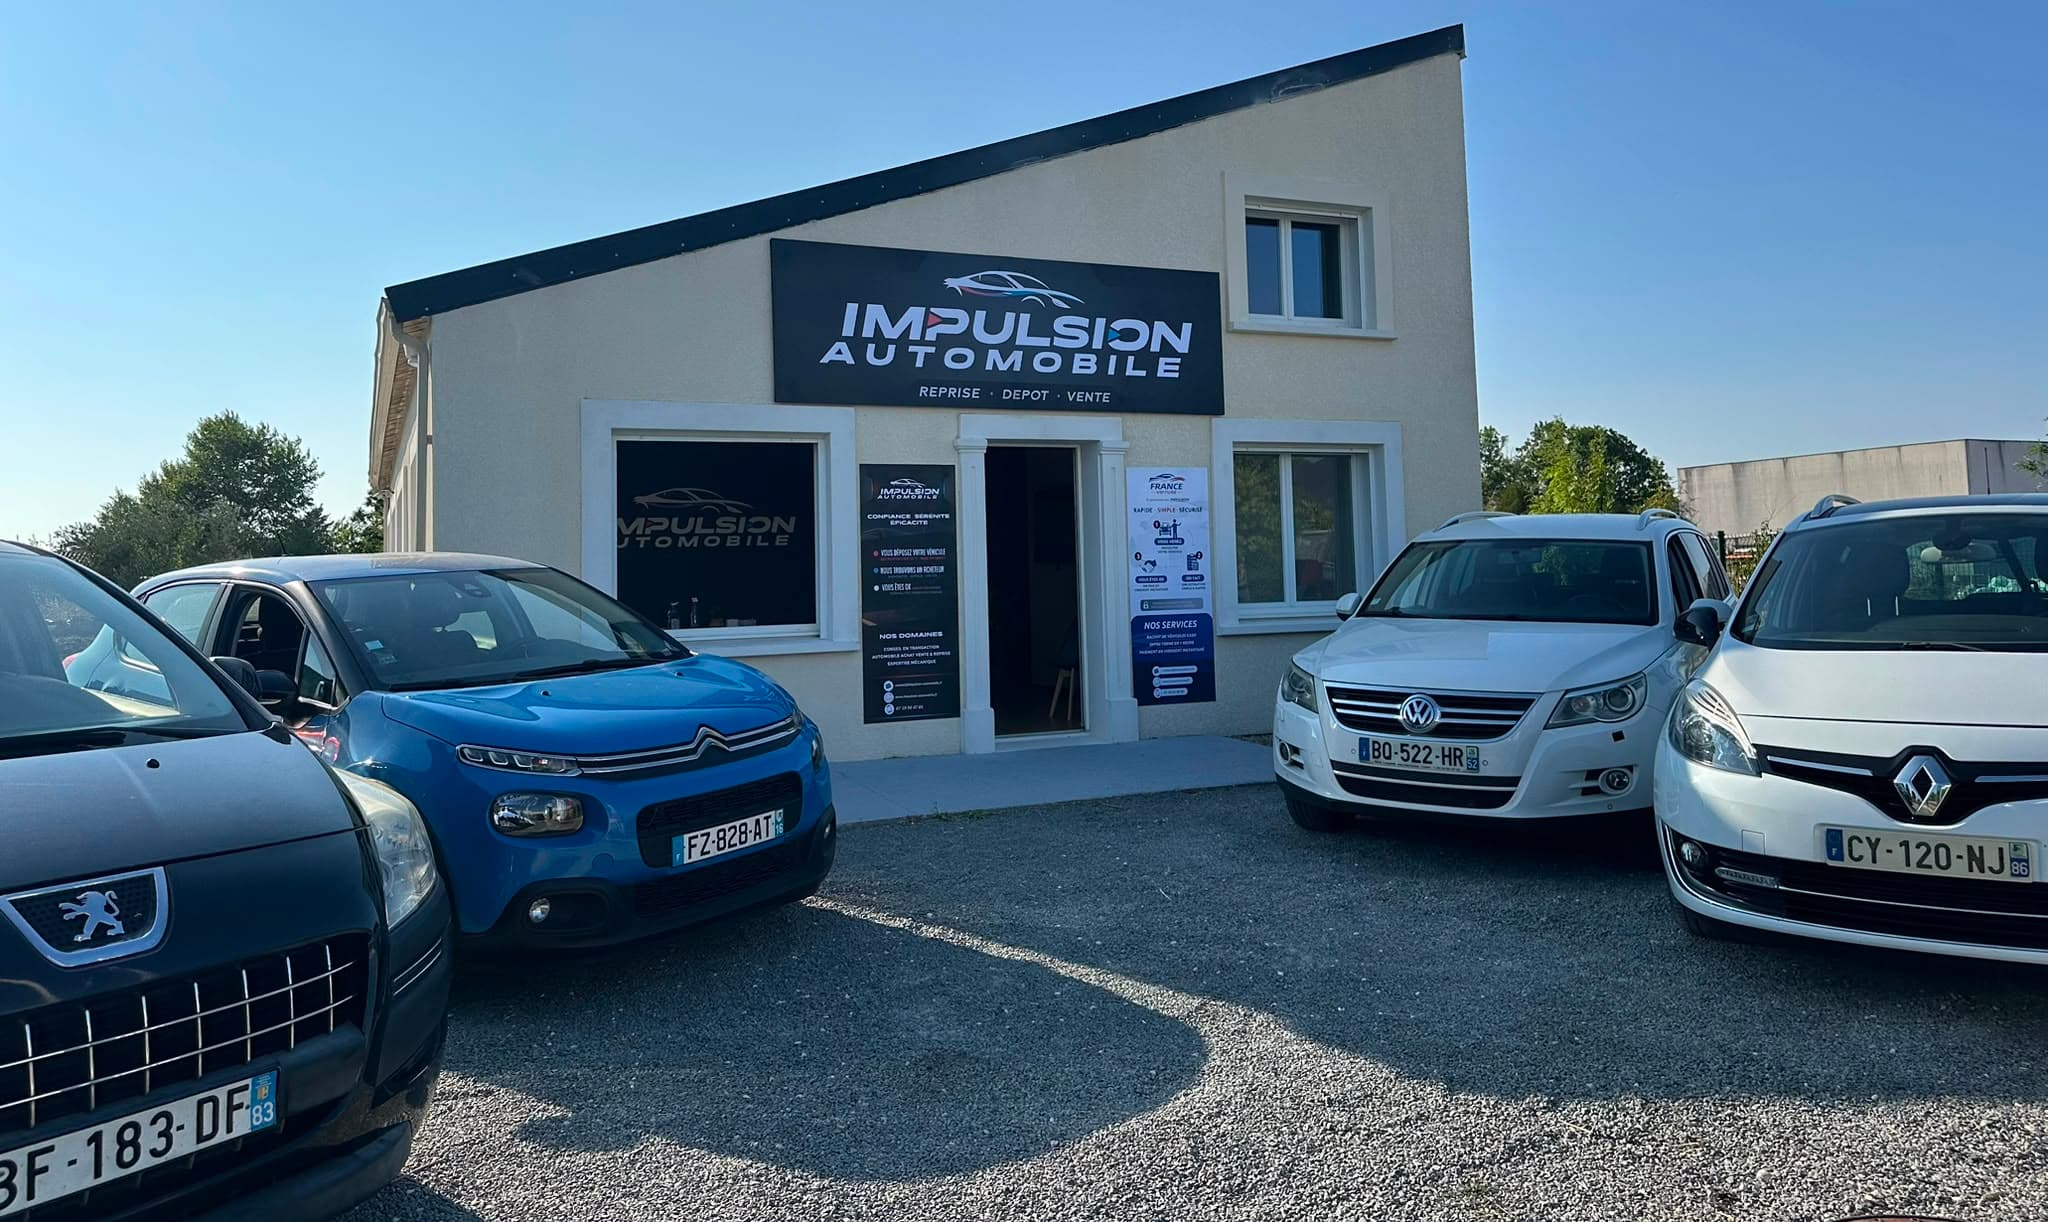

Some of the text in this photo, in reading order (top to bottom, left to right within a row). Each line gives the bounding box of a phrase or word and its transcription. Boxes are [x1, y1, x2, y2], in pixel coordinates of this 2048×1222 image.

[841, 303, 1193, 354] IMPULSION
[819, 341, 1182, 379] AUTOMOBILE
[919, 386, 1111, 403] REPRISE DEPOT VENTE
[618, 516, 796, 535] MPULSION
[617, 535, 790, 548] UTOMOBILE
[1144, 620, 1198, 630] NOS SERVICES
[898, 631, 943, 639] DOMAINES
[1372, 740, 1464, 767] BQ-522-HR
[1467, 759, 1478, 769] 52
[687, 815, 772, 860] FZ-828-AT
[1847, 835, 2005, 874] CY-120-NJ
[2010, 861, 2028, 876] 86
[252, 1101, 275, 1126] 83
